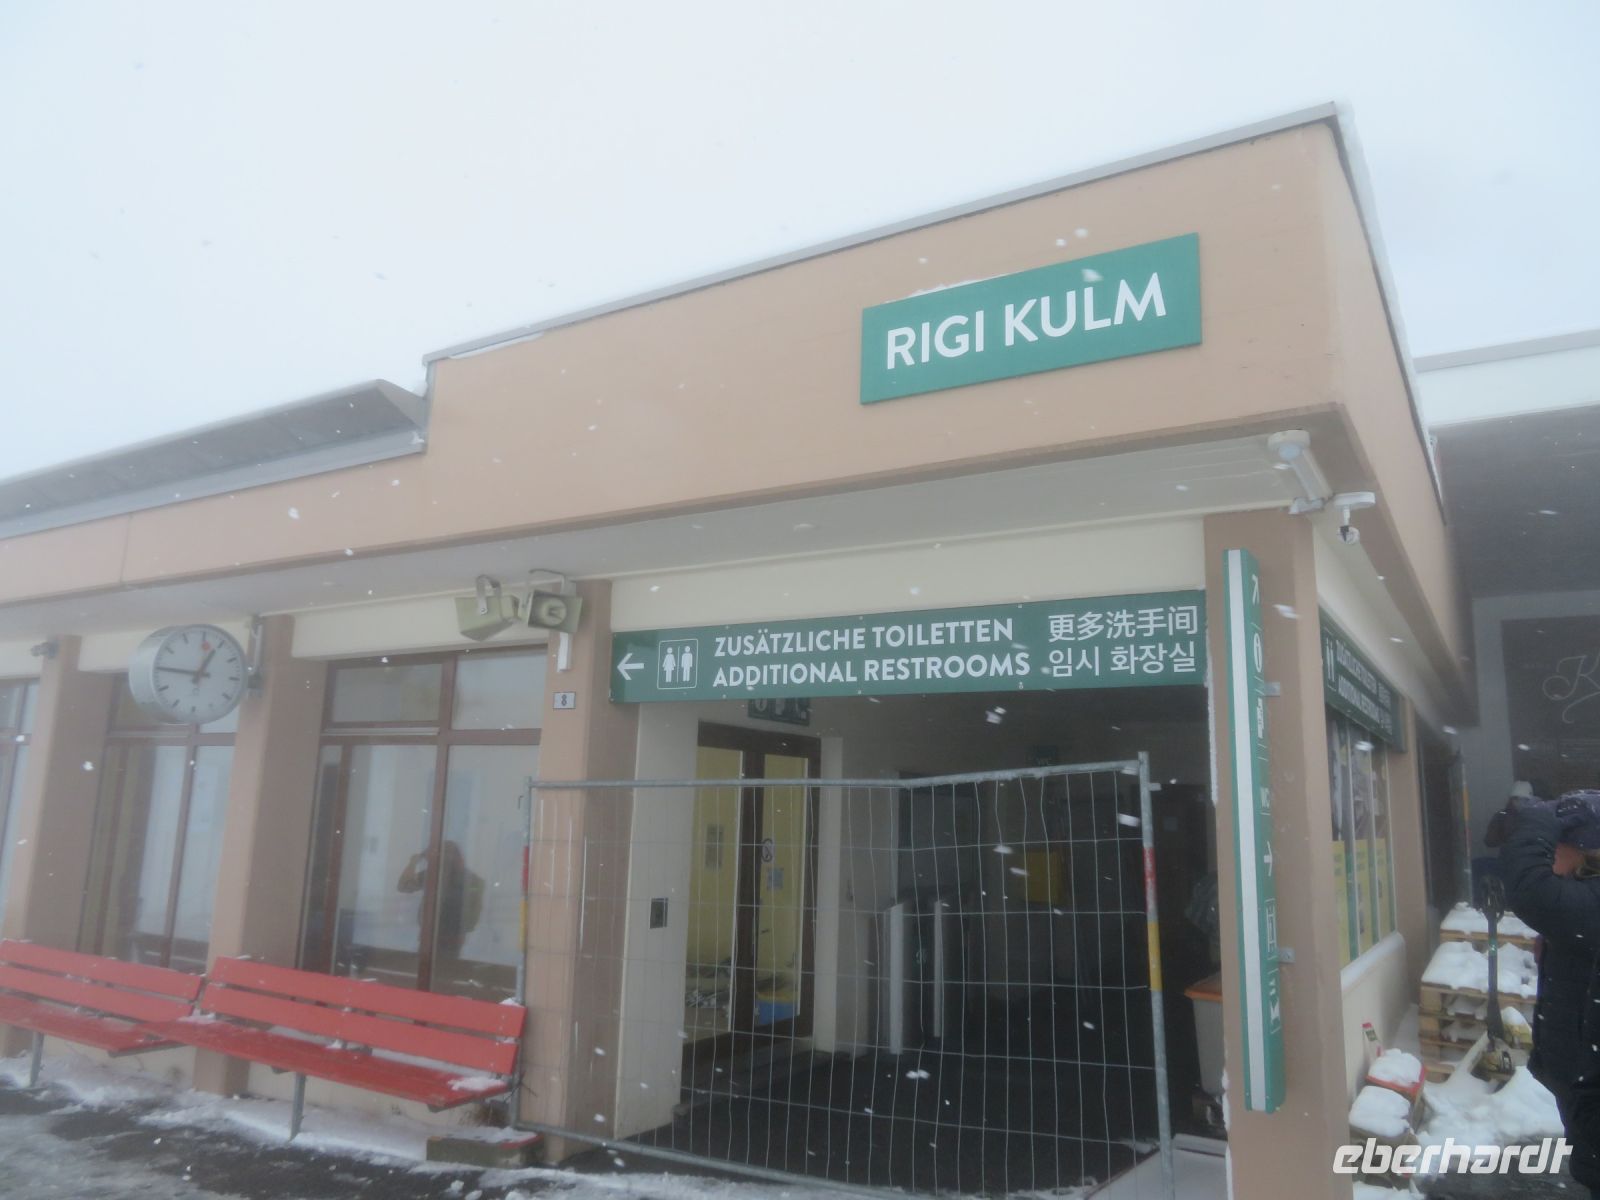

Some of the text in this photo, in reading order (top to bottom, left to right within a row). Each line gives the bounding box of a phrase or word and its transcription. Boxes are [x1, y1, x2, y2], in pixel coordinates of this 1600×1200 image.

[887, 272, 1167, 370] RIGI KULM
[714, 617, 1013, 657] ZUSÄTZLICHE TOILETTEN
[1048, 605, 1198, 643] 更多洗手间
[712, 652, 1031, 687] ADDITIONAL RESTROOMS
[1049, 641, 1196, 678] 임시 화장실
[561, 694, 568, 707] 8
